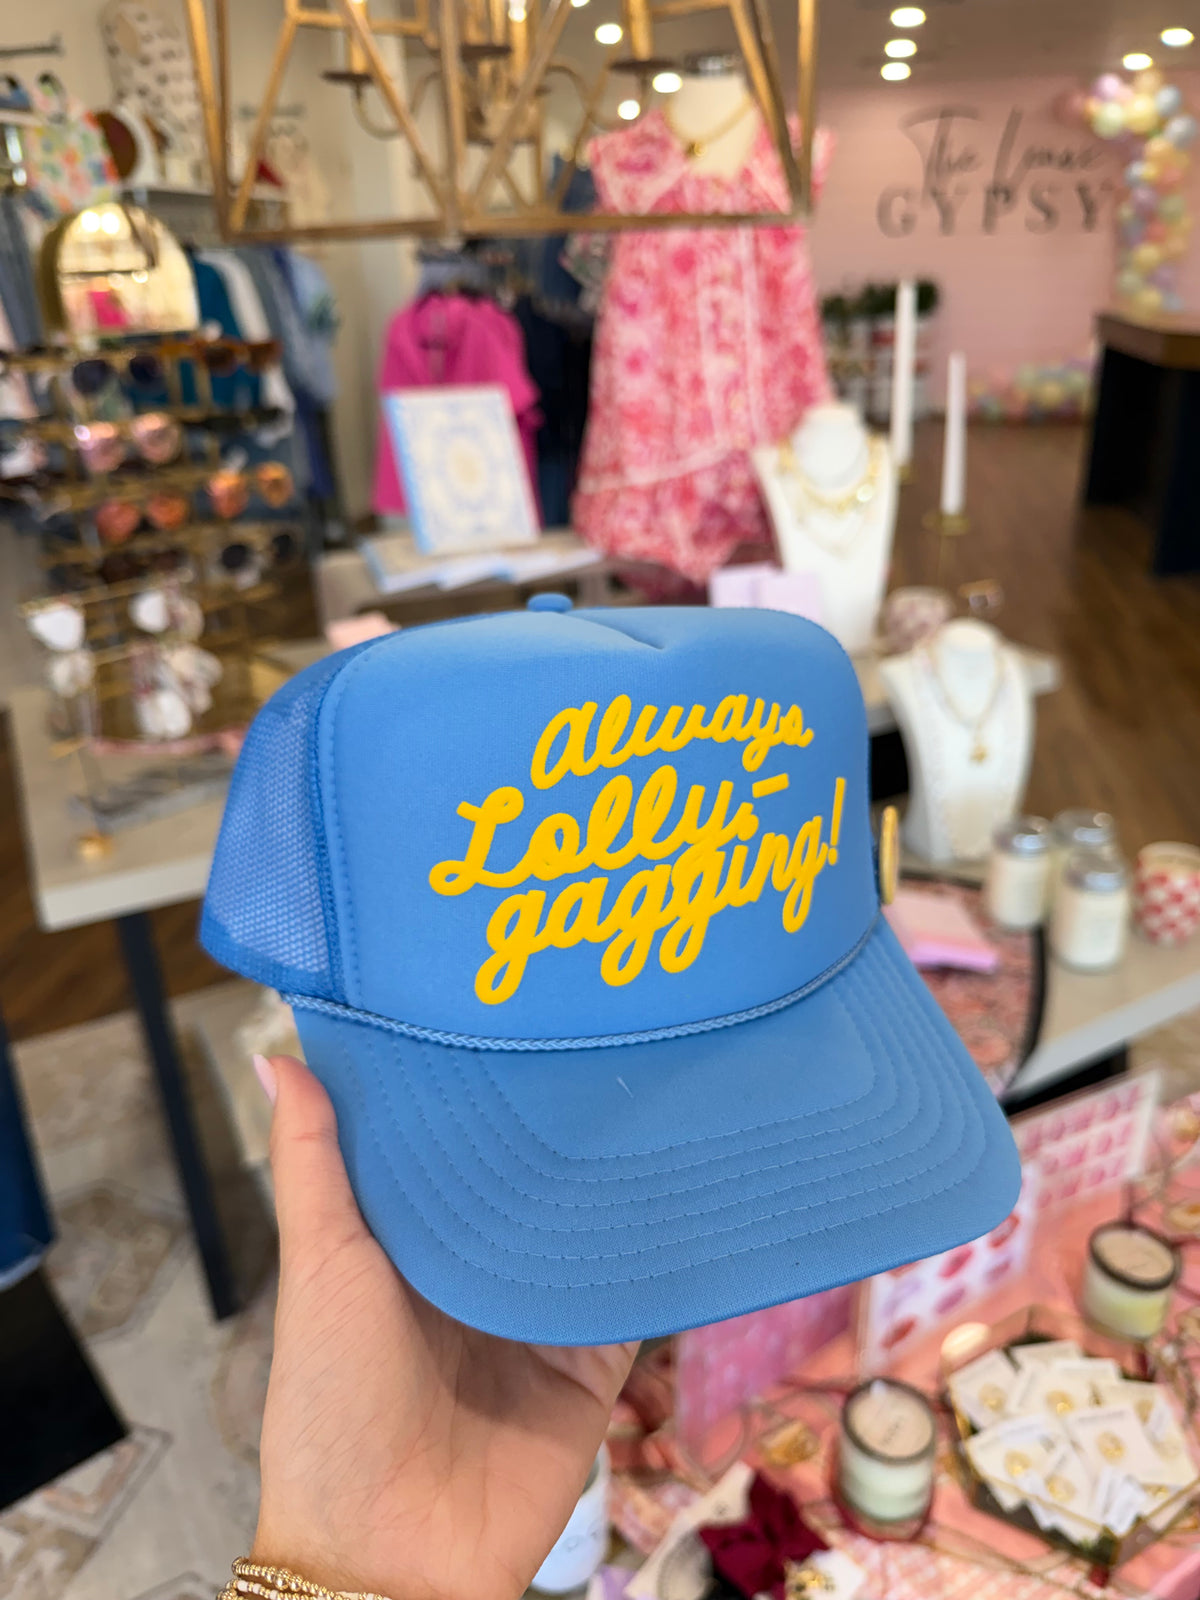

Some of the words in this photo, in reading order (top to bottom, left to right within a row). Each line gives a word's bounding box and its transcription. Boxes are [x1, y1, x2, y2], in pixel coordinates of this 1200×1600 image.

[877, 183, 1112, 237] GYPSY
[531, 694, 814, 790] Always
[475, 777, 846, 1005] gagging!
